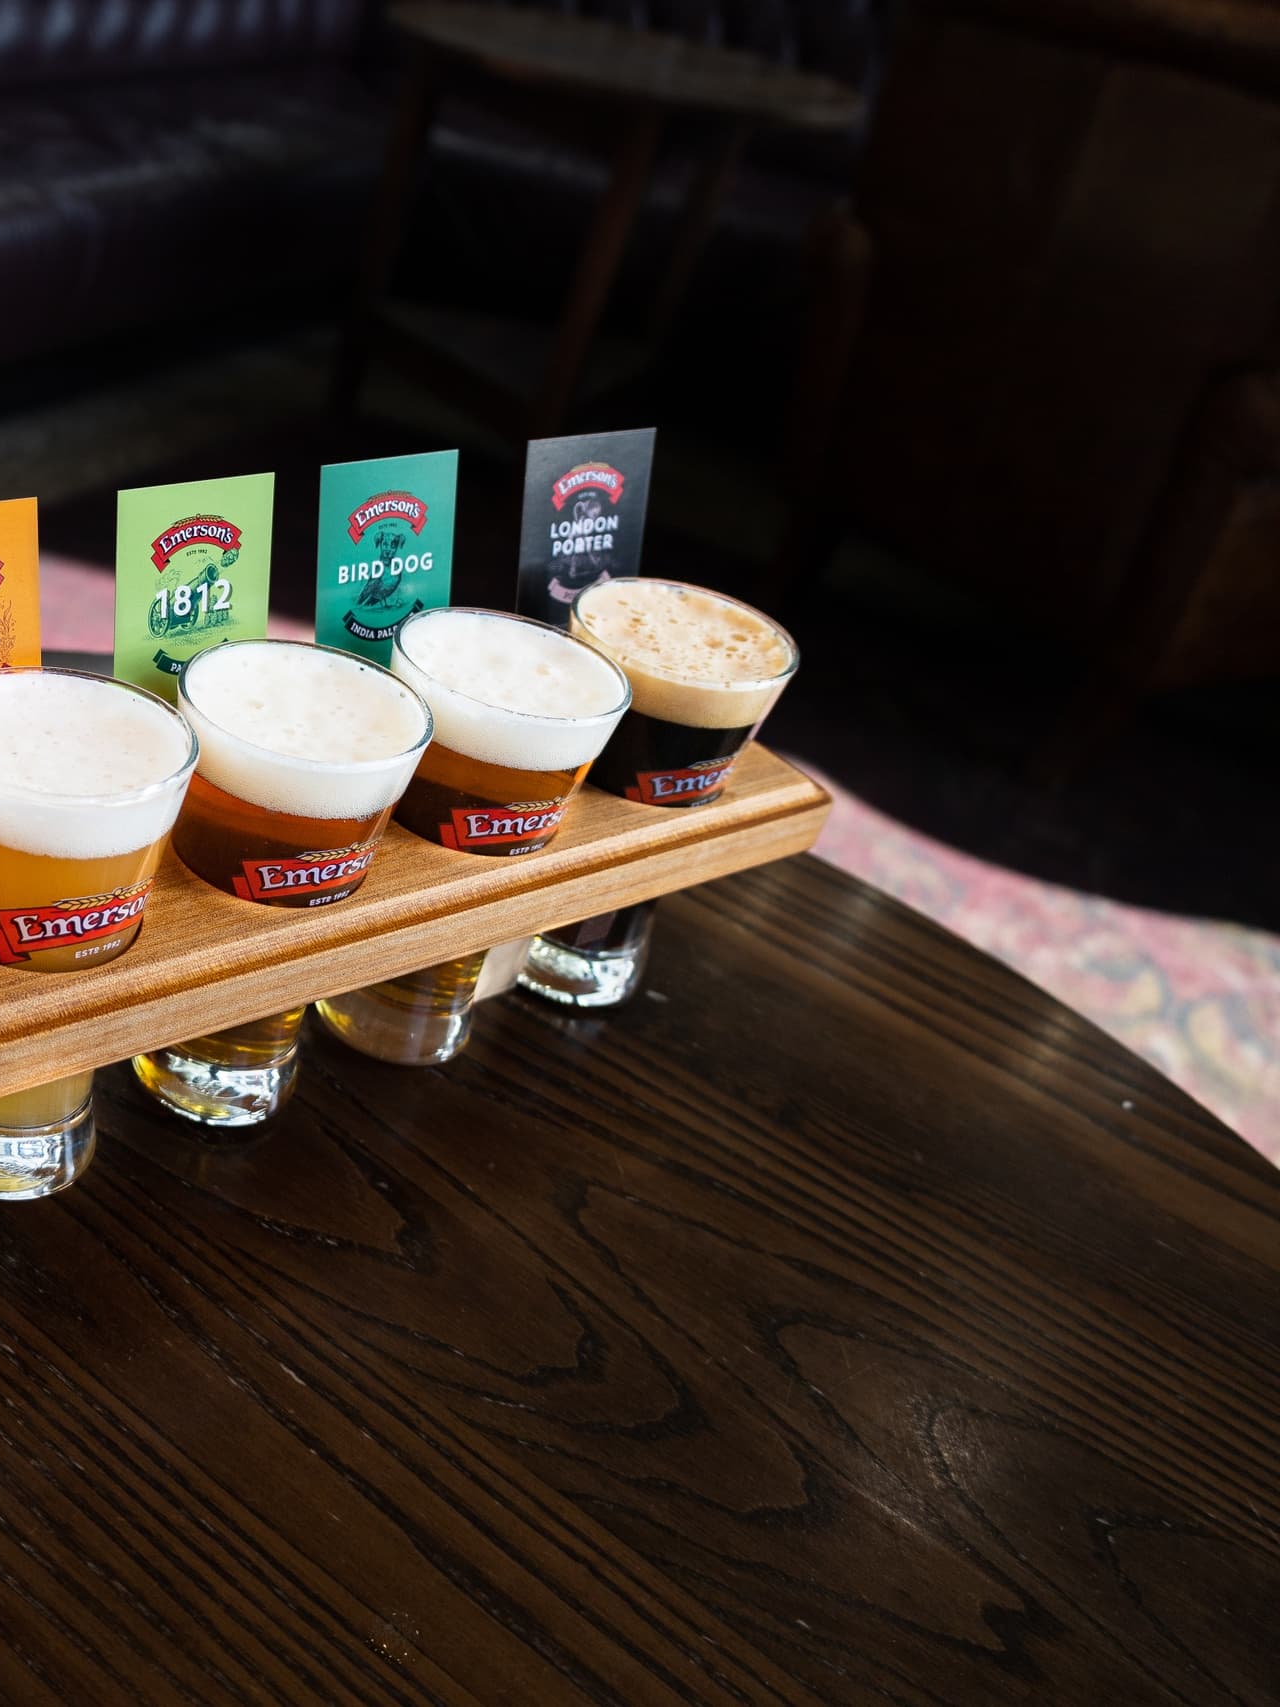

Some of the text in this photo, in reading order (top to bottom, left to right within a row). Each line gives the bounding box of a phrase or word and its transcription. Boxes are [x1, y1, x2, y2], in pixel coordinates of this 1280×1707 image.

[355, 500, 420, 526] Emerson's
[159, 525, 233, 552] Emerson's
[550, 515, 619, 539] LONDON
[552, 534, 614, 557] PORTER
[338, 552, 433, 584] BIRD DOG
[156, 579, 232, 619] 1812
[350, 622, 375, 639] INDIA
